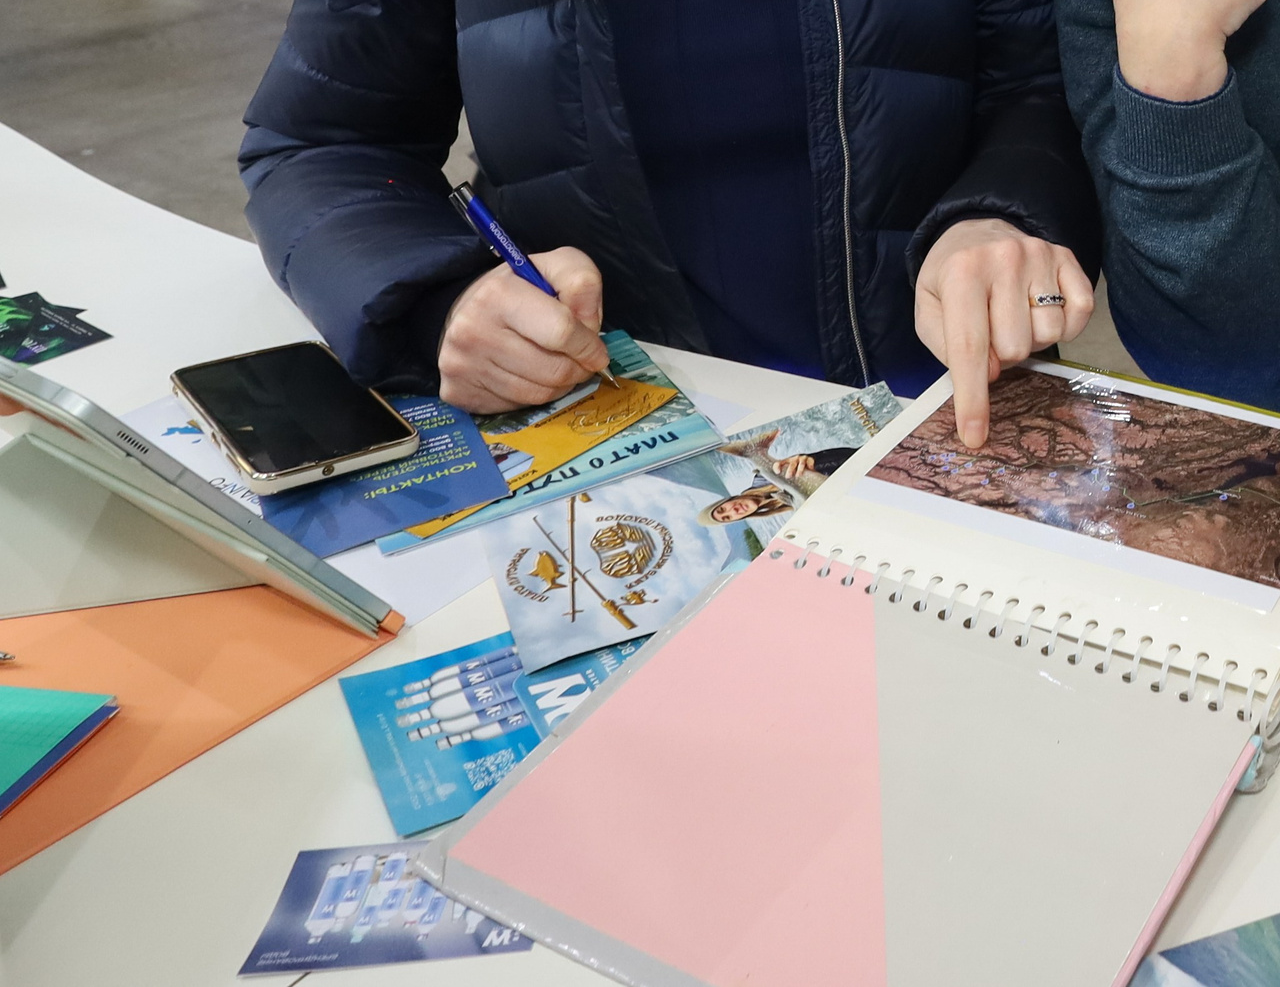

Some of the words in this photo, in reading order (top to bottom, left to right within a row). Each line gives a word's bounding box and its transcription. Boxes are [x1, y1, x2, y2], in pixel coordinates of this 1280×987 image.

[849, 397, 880, 437] ТАРАМА
[373, 450, 471, 481] АРКТИК-ОТЕЛЬ
[589, 430, 680, 469] ПЛАТО
[364, 461, 478, 500] КОНТАКТЫ:
[585, 668, 601, 689] ATER
